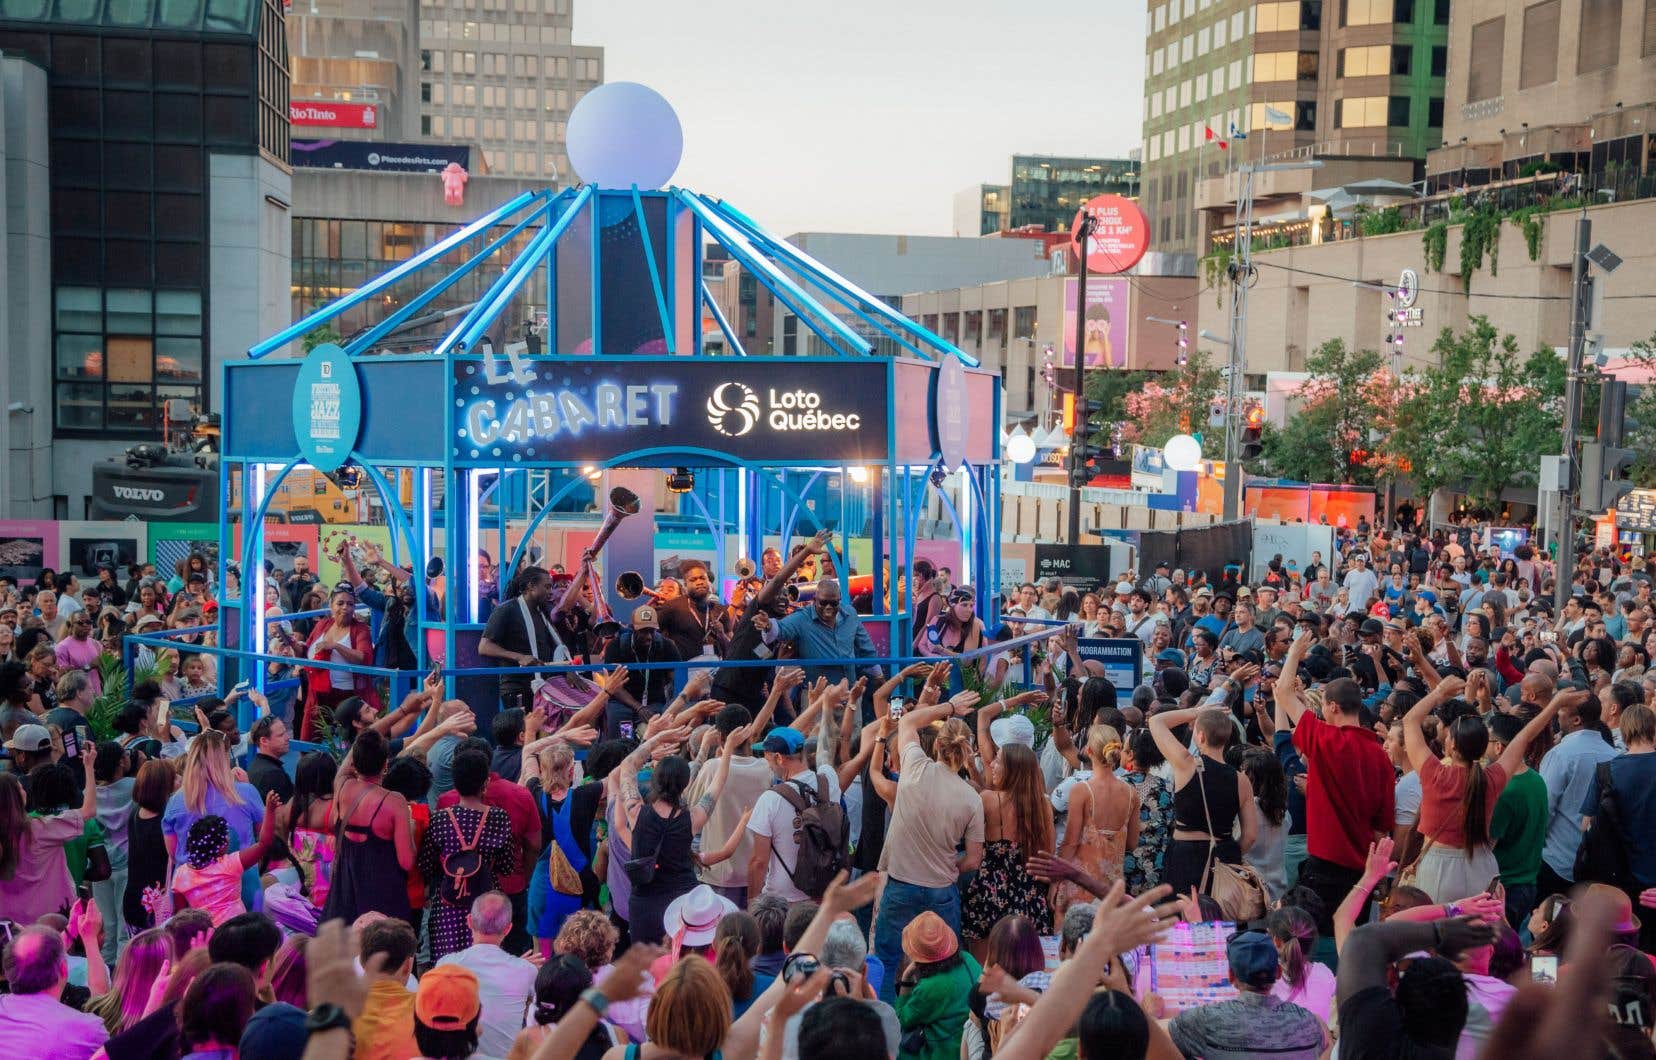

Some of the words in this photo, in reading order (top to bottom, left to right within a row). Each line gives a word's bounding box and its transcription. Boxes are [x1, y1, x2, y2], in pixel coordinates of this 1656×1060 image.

[482, 341, 538, 385] LE
[769, 388, 821, 409] Loto
[469, 384, 678, 446] CABARET
[768, 408, 861, 431] Québec
[112, 485, 165, 501] VOLVO
[290, 513, 314, 523] VOLVO
[1052, 559, 1071, 569] MAC
[1076, 645, 1132, 657] PROGRAMMATION
